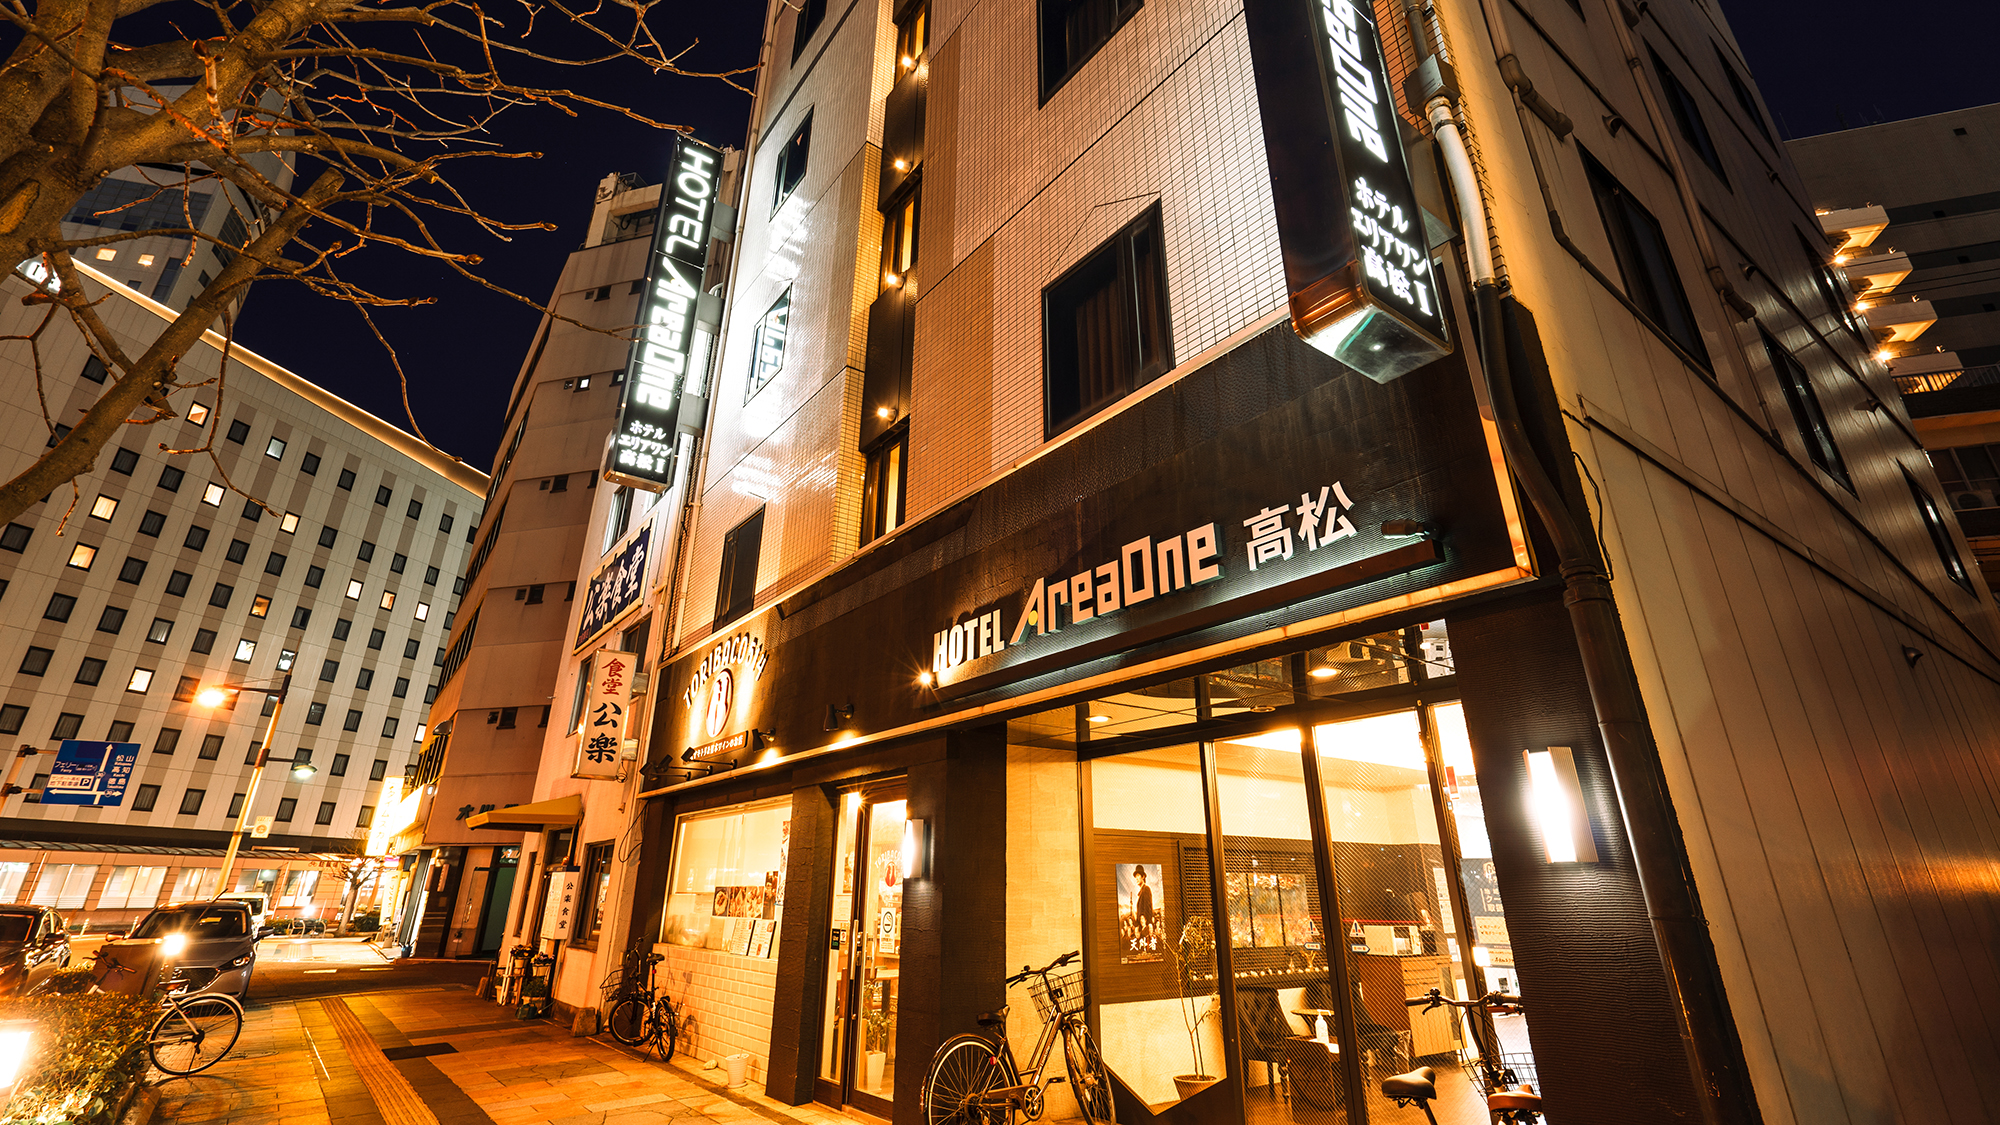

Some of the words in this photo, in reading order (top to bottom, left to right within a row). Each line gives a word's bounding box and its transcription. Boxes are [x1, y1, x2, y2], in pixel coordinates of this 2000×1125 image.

[664, 146, 715, 255] HOTEL
[1355, 176, 1409, 233] ホテル
[1351, 206, 1427, 276] エリアワン
[636, 256, 697, 411] AreaOne
[617, 433, 673, 457] エリアワン
[629, 419, 667, 440] ホテル
[582, 543, 645, 631] 公楽食堂
[932, 608, 1005, 673] HOTEL
[1008, 521, 1224, 646] AreaOne
[1242, 480, 1359, 572] 高松
[601, 657, 626, 696] 食堂
[585, 701, 622, 764] 公楽
[559, 882, 574, 930] 公楽食堂
